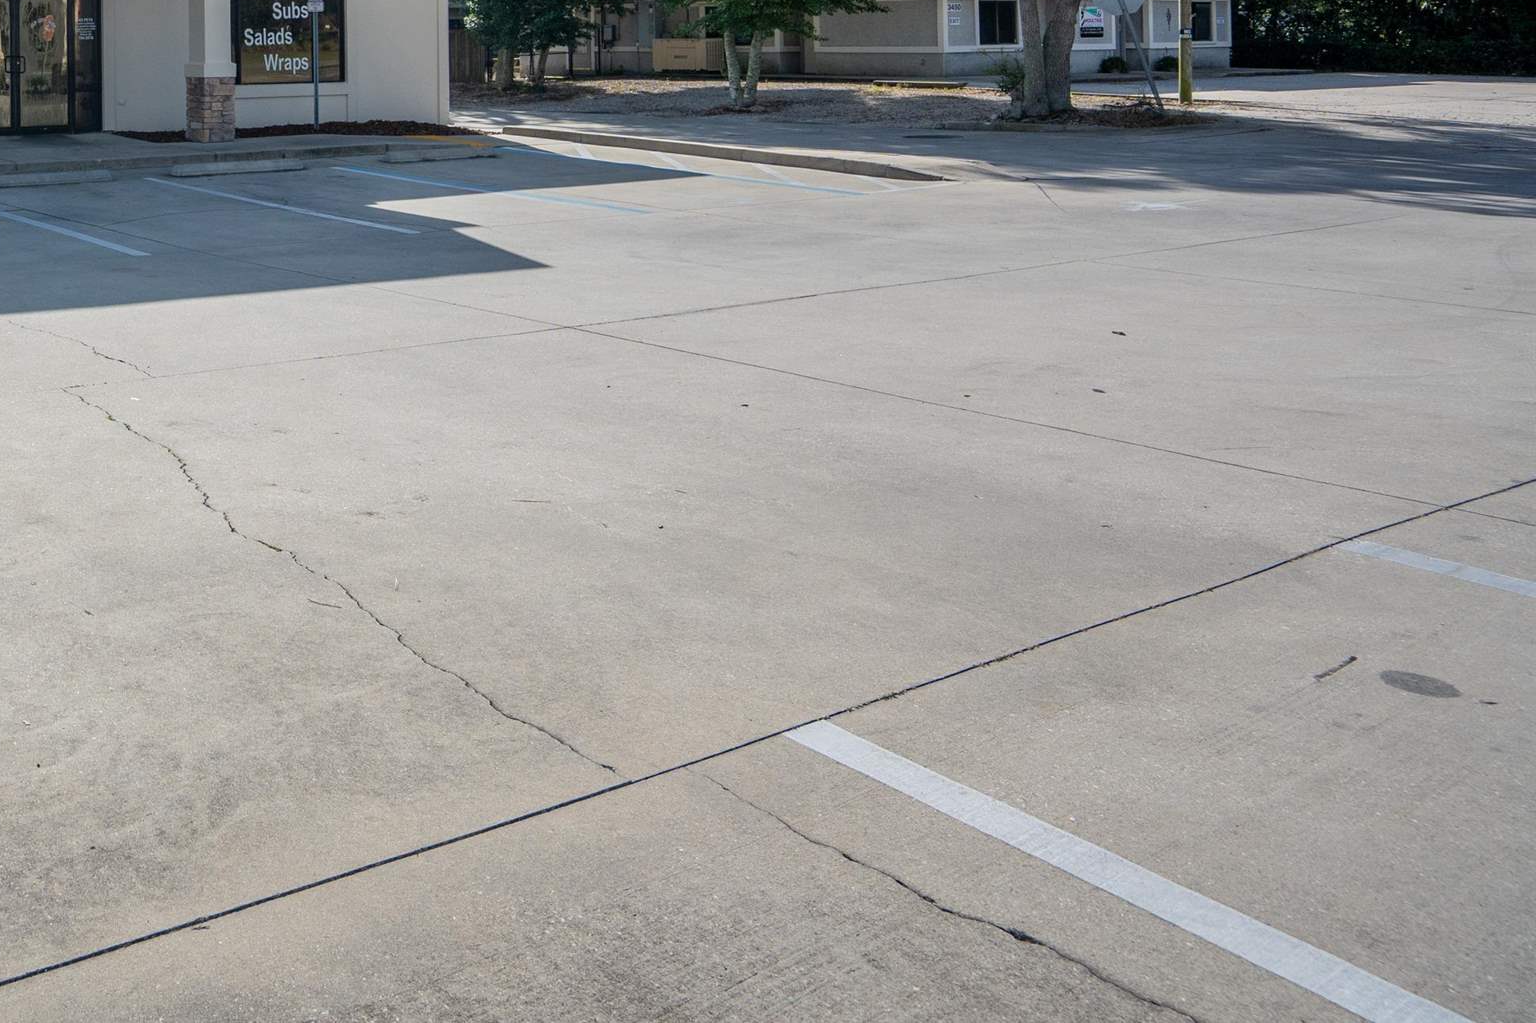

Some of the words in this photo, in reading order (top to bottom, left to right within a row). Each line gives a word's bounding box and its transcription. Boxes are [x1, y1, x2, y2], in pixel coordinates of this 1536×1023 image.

[272, 2, 309, 20] Subs
[244, 28, 293, 46] Salads
[263, 54, 309, 74] Wraps
